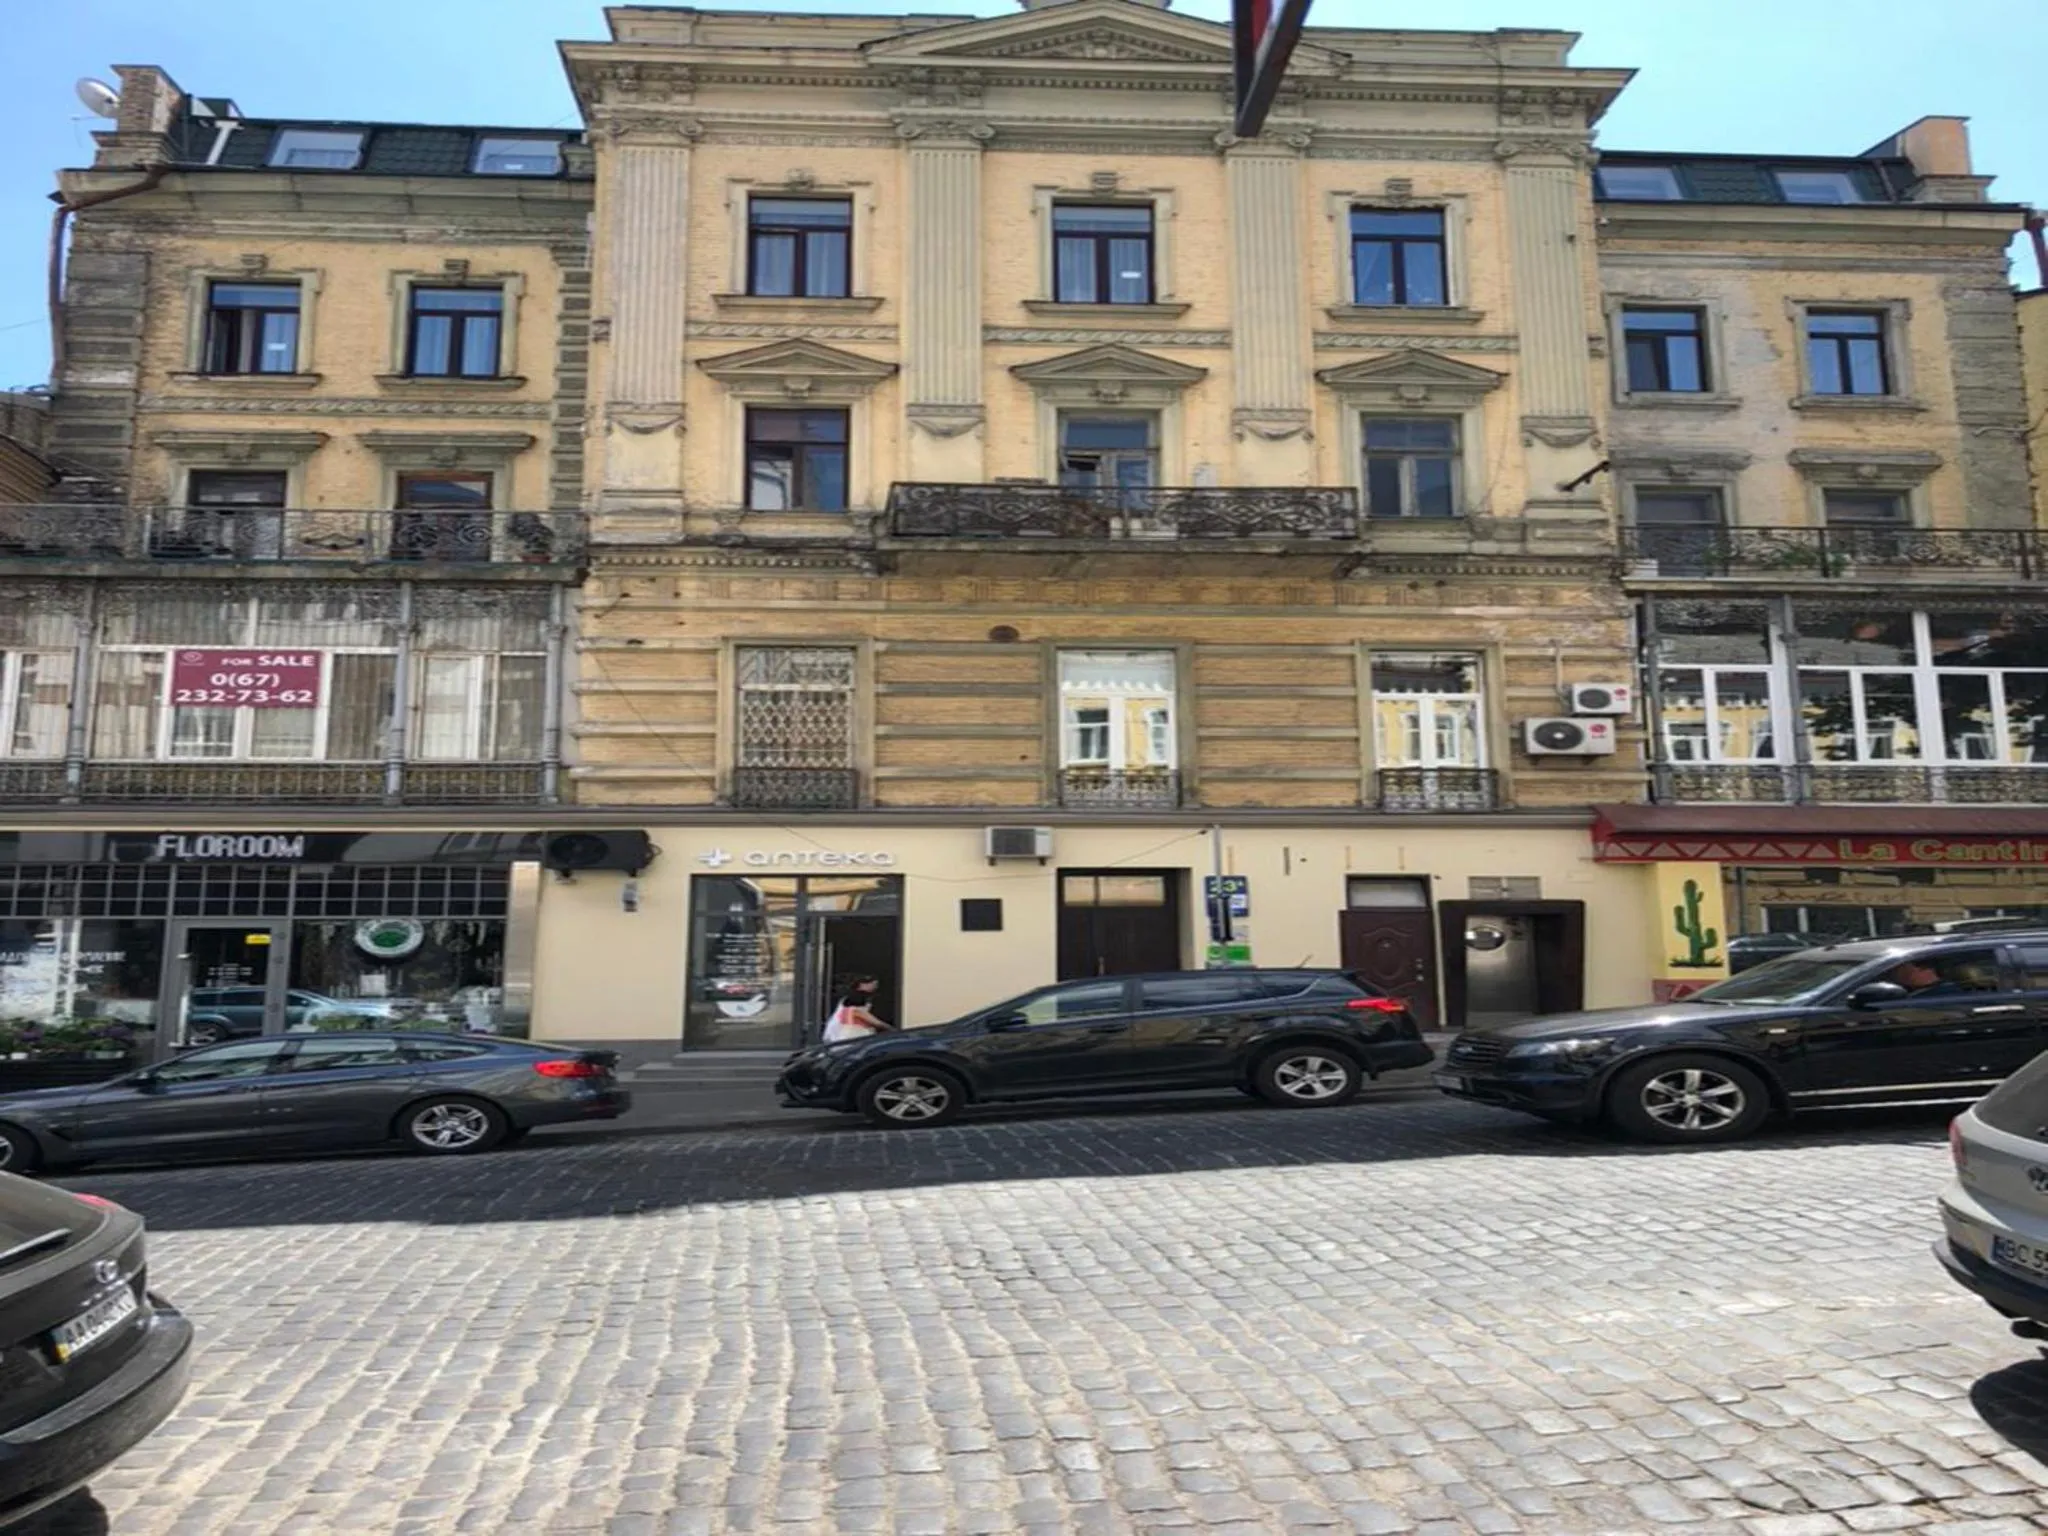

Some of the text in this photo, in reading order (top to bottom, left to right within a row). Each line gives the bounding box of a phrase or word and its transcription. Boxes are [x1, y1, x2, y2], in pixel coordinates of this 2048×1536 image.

[221, 655, 316, 667] FOR SALE
[210, 673, 280, 687] 0(67)
[176, 689, 313, 703] 232-73-62
[155, 834, 304, 858] FLOROOM
[1838, 838, 1897, 861] La
[743, 849, 896, 867] аптека
